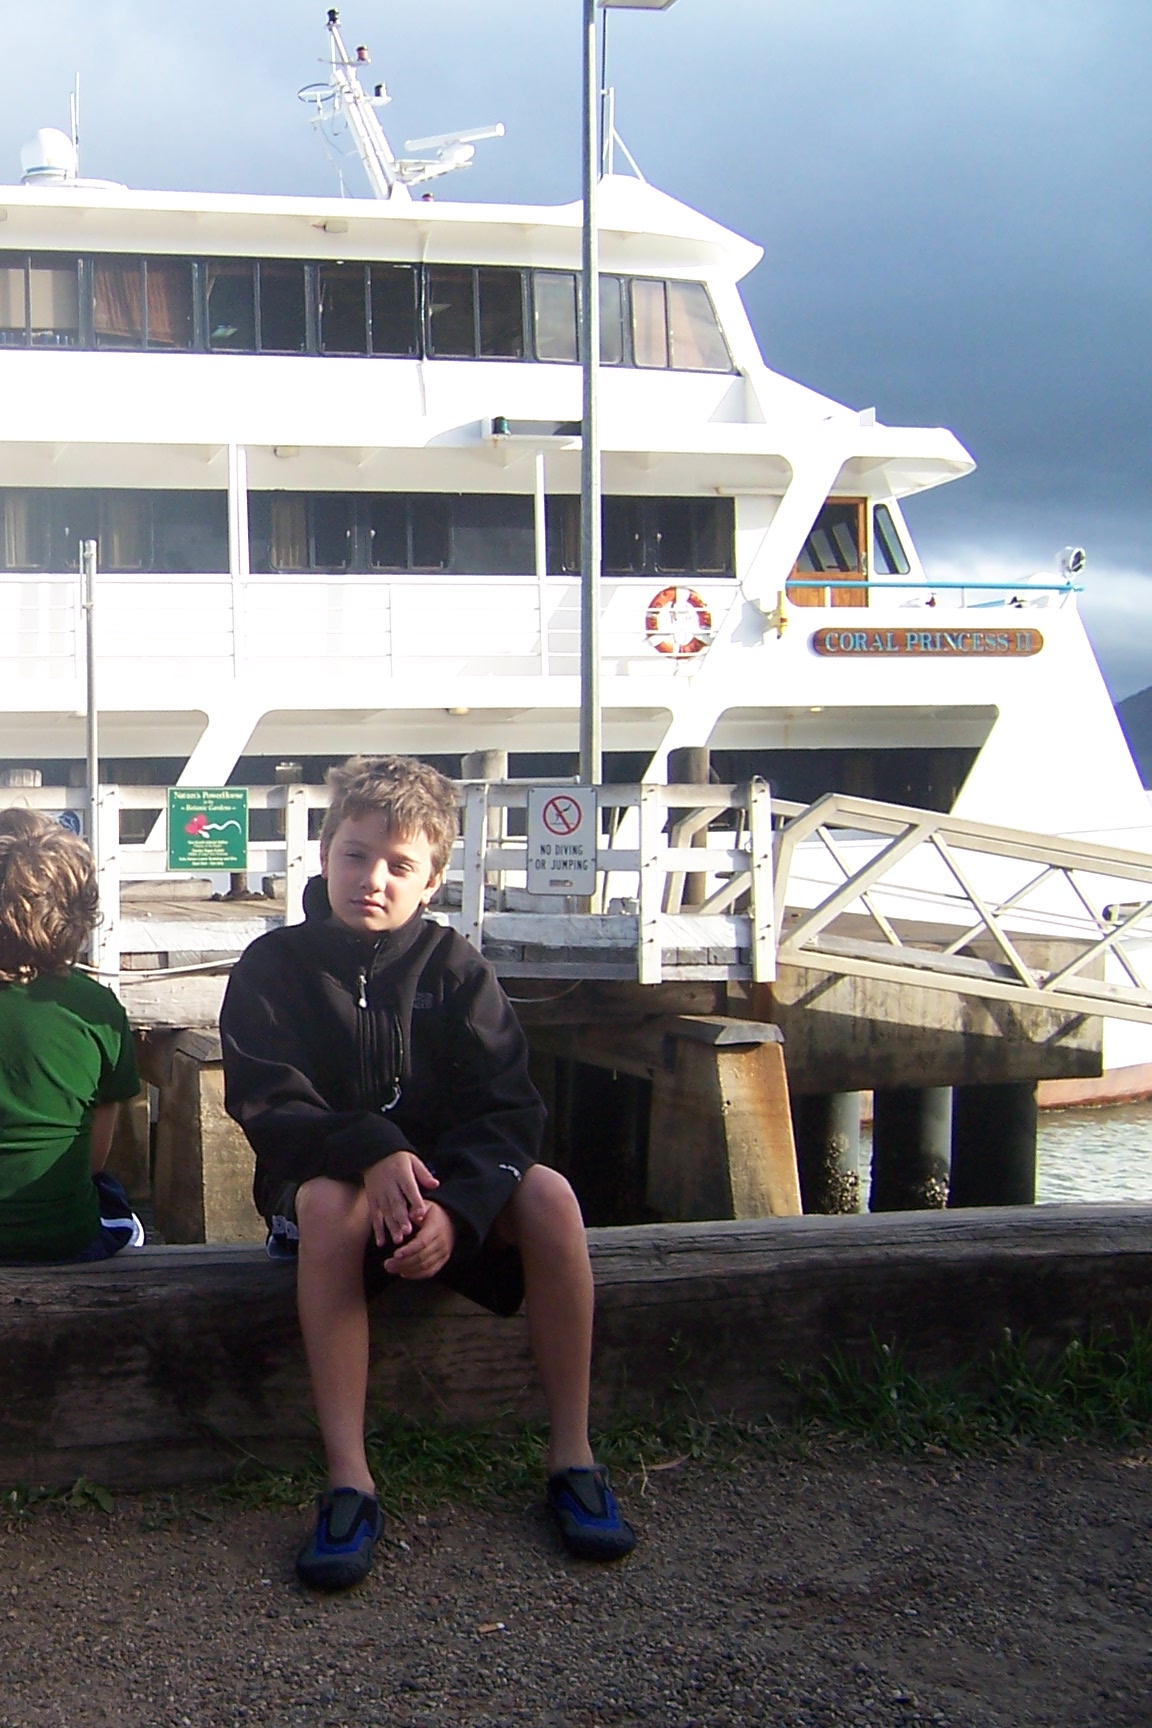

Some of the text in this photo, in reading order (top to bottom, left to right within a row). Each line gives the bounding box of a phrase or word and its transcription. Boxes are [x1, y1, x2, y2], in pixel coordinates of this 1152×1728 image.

[824, 631, 1033, 653] CORAL PRINCESS II
[540, 844, 583, 856] NO DIVING
[535, 859, 588, 870] OR JUMPING
